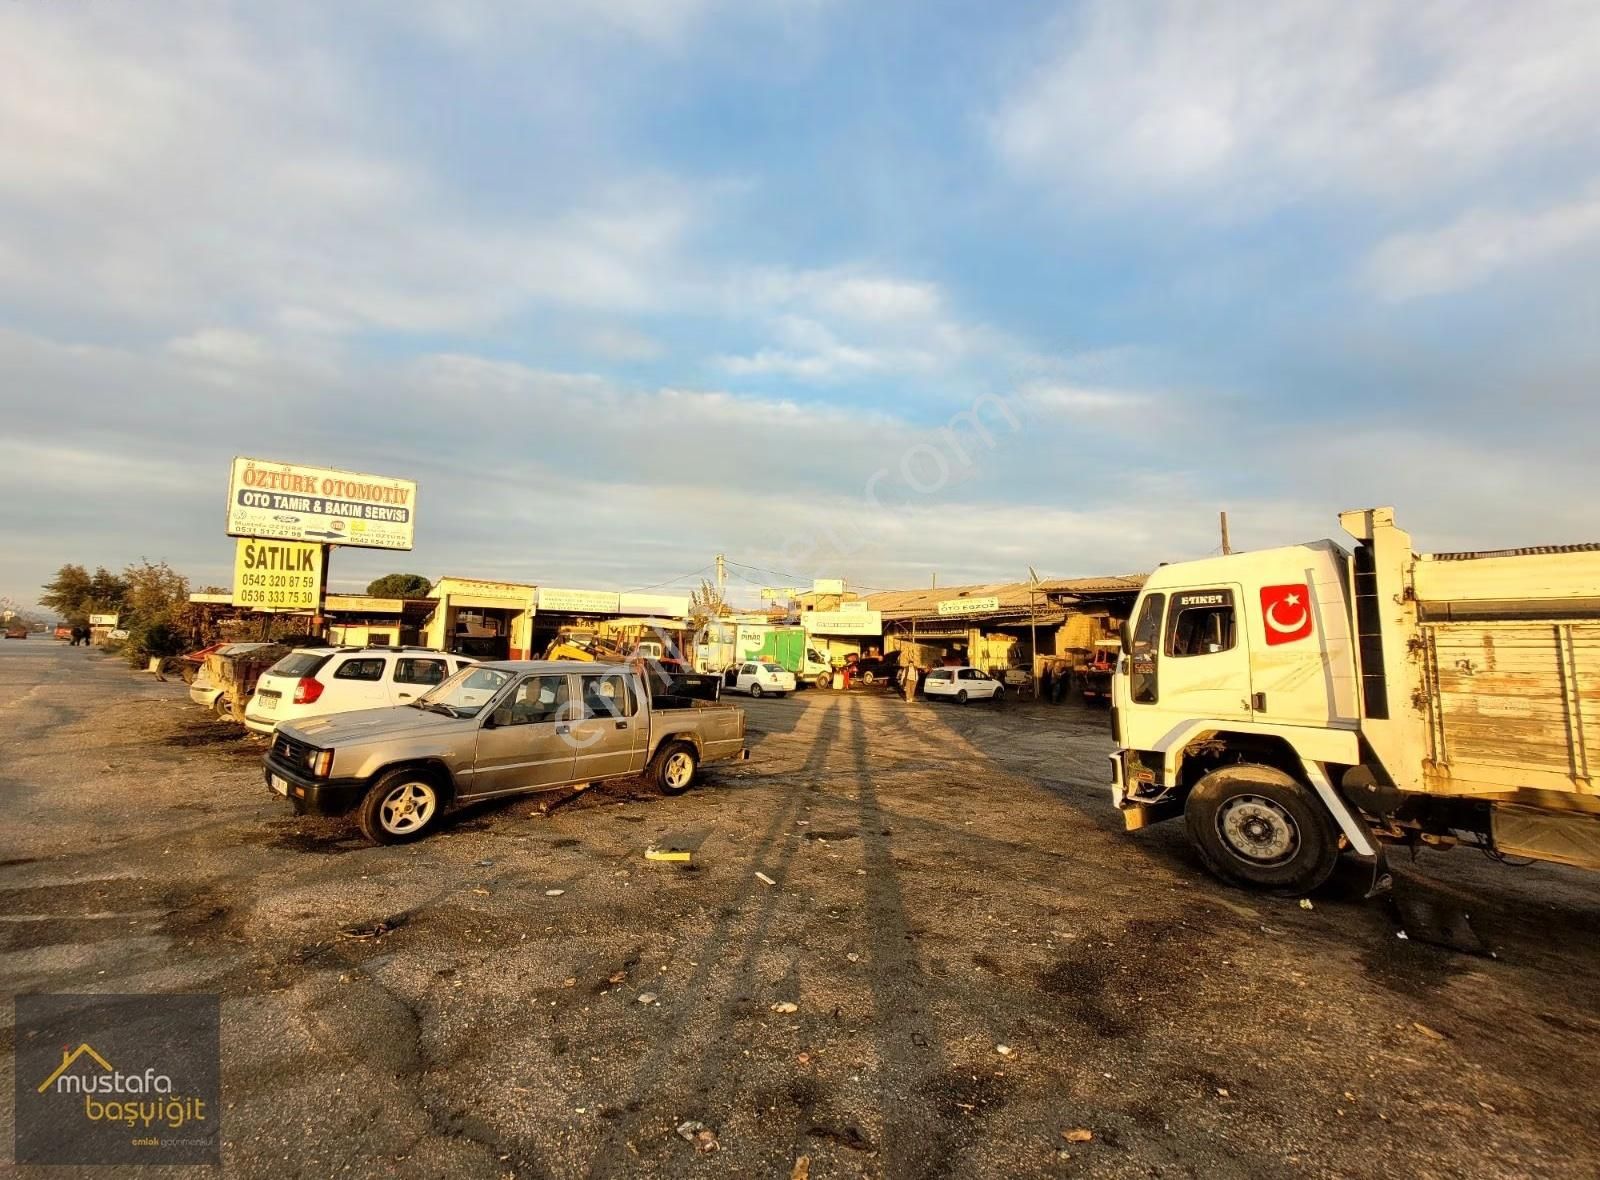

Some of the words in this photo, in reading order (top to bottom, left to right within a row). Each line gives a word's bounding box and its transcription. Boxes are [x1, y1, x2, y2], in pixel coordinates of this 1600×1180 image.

[243, 462, 318, 493] ÖZTÜRK
[322, 478, 409, 504] OTOMOTİV
[243, 492, 270, 507] OTO
[313, 500, 322, 513] &
[325, 500, 362, 518] BAKIM
[244, 545, 314, 571] SATILIK
[242, 573, 266, 587] 0542
[269, 575, 286, 588] 320
[289, 576, 300, 588] 87
[303, 576, 314, 588] 59
[241, 589, 265, 602] 0536
[268, 590, 285, 603] 333
[288, 591, 299, 603] 75
[301, 591, 313, 604] 30
[1181, 594, 1223, 605] ETIKET
